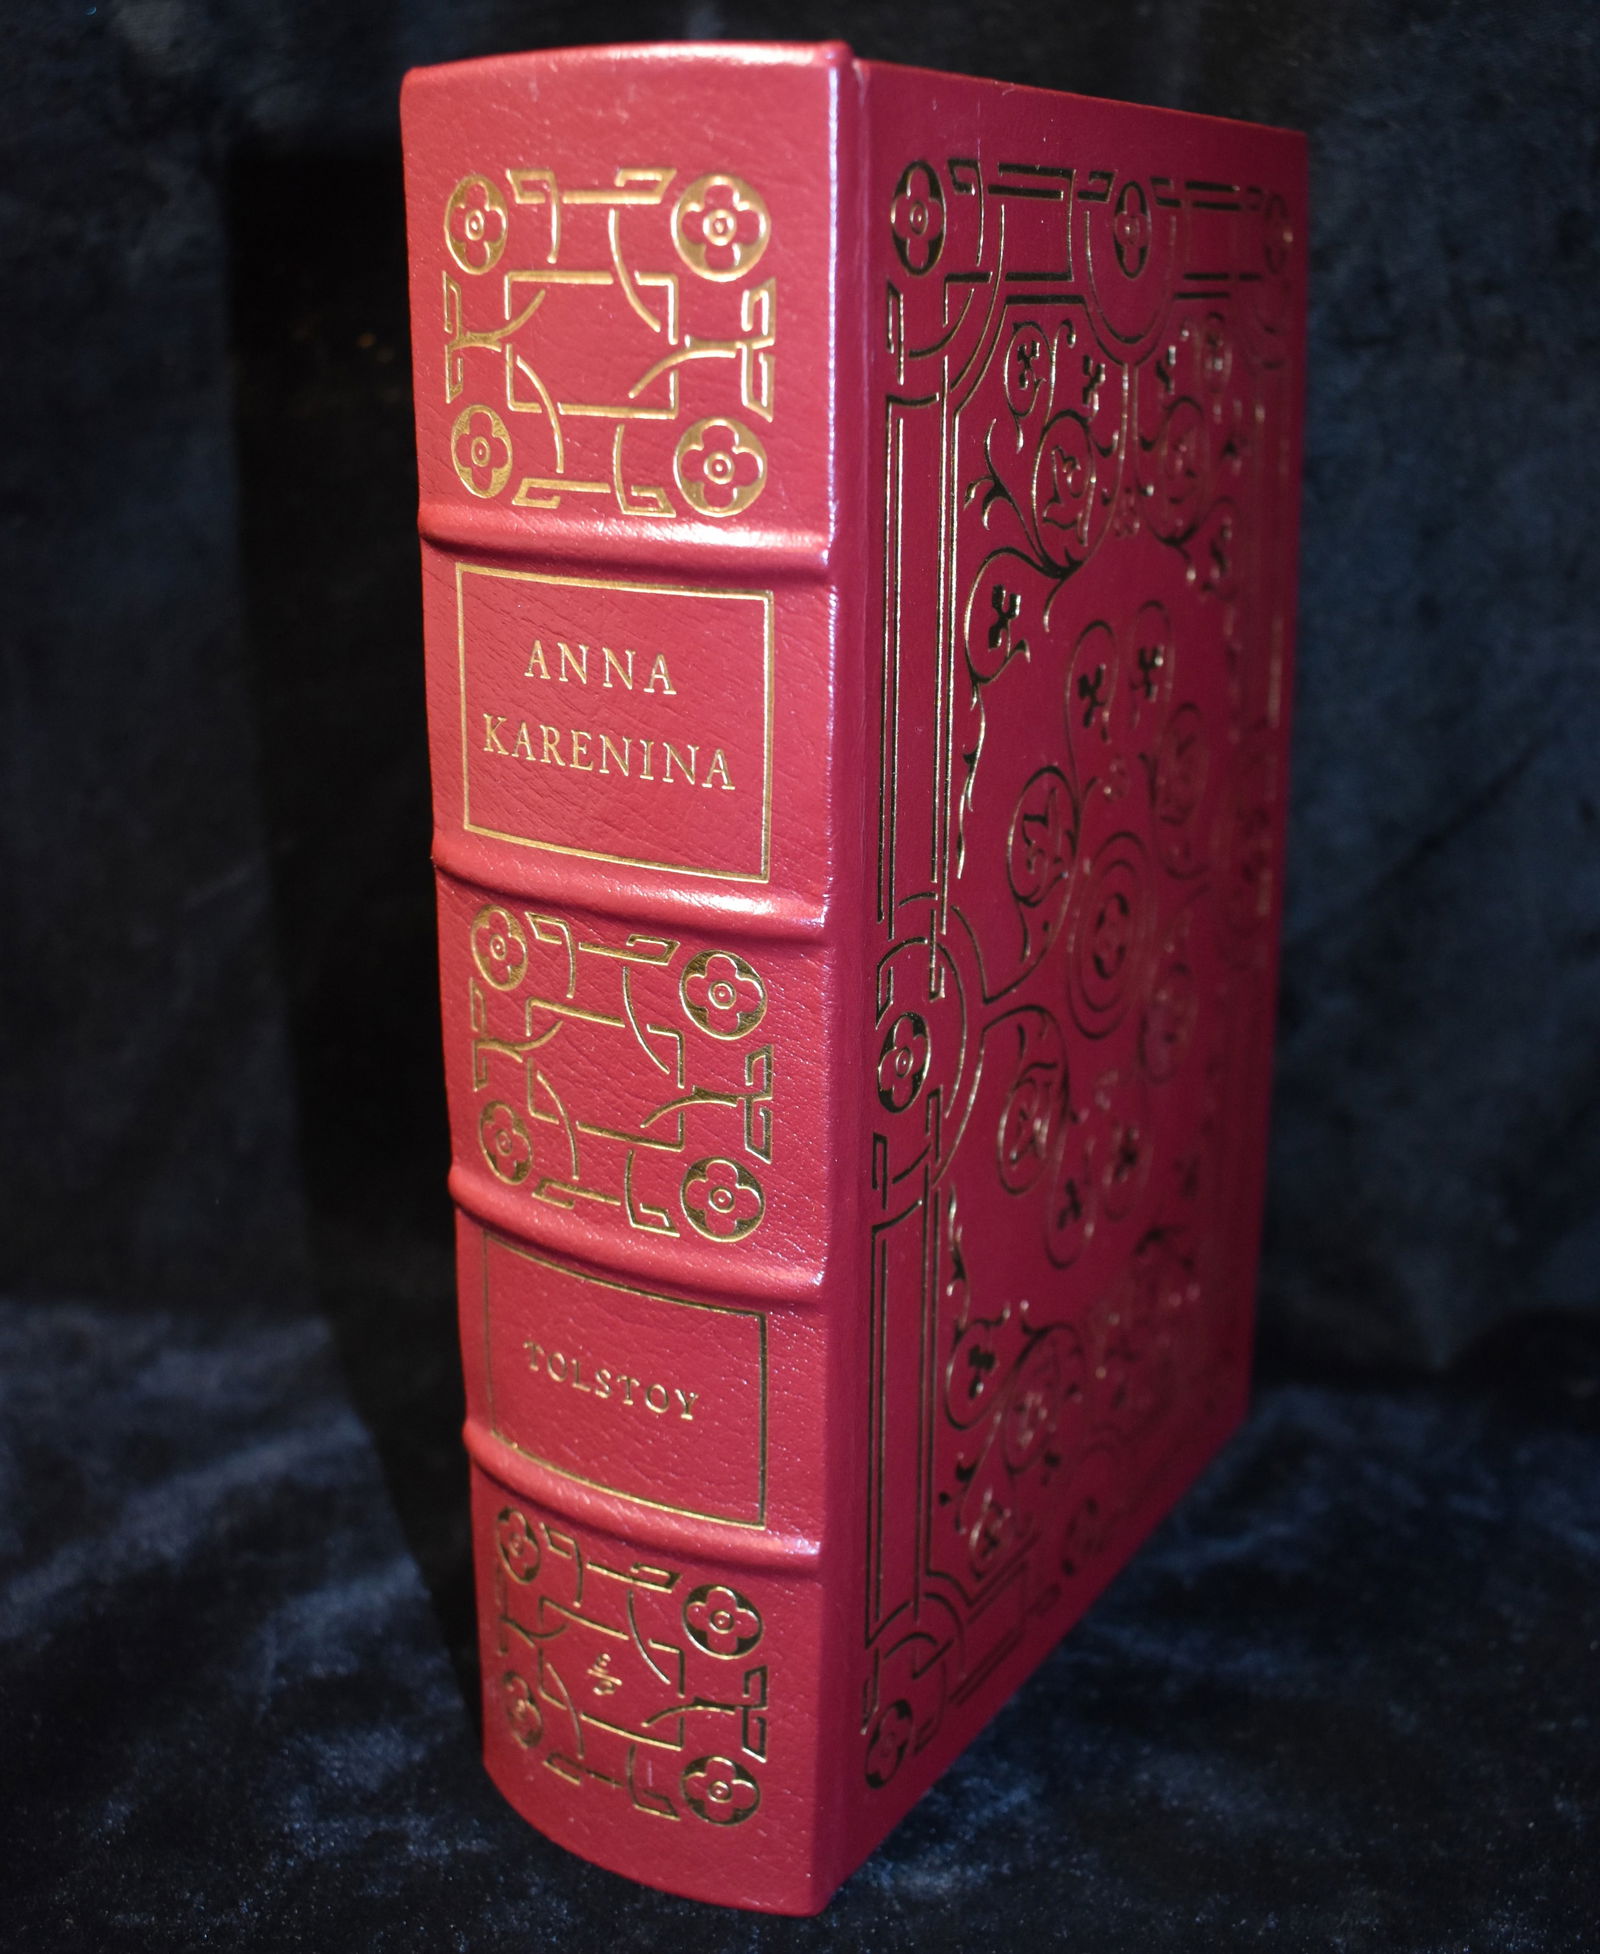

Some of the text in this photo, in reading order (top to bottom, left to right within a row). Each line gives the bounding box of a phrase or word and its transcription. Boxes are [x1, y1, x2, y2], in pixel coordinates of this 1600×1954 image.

[524, 639, 677, 695] ANNA
[483, 713, 735, 790] KARENINA
[522, 1341, 699, 1421] TOLSTOY
